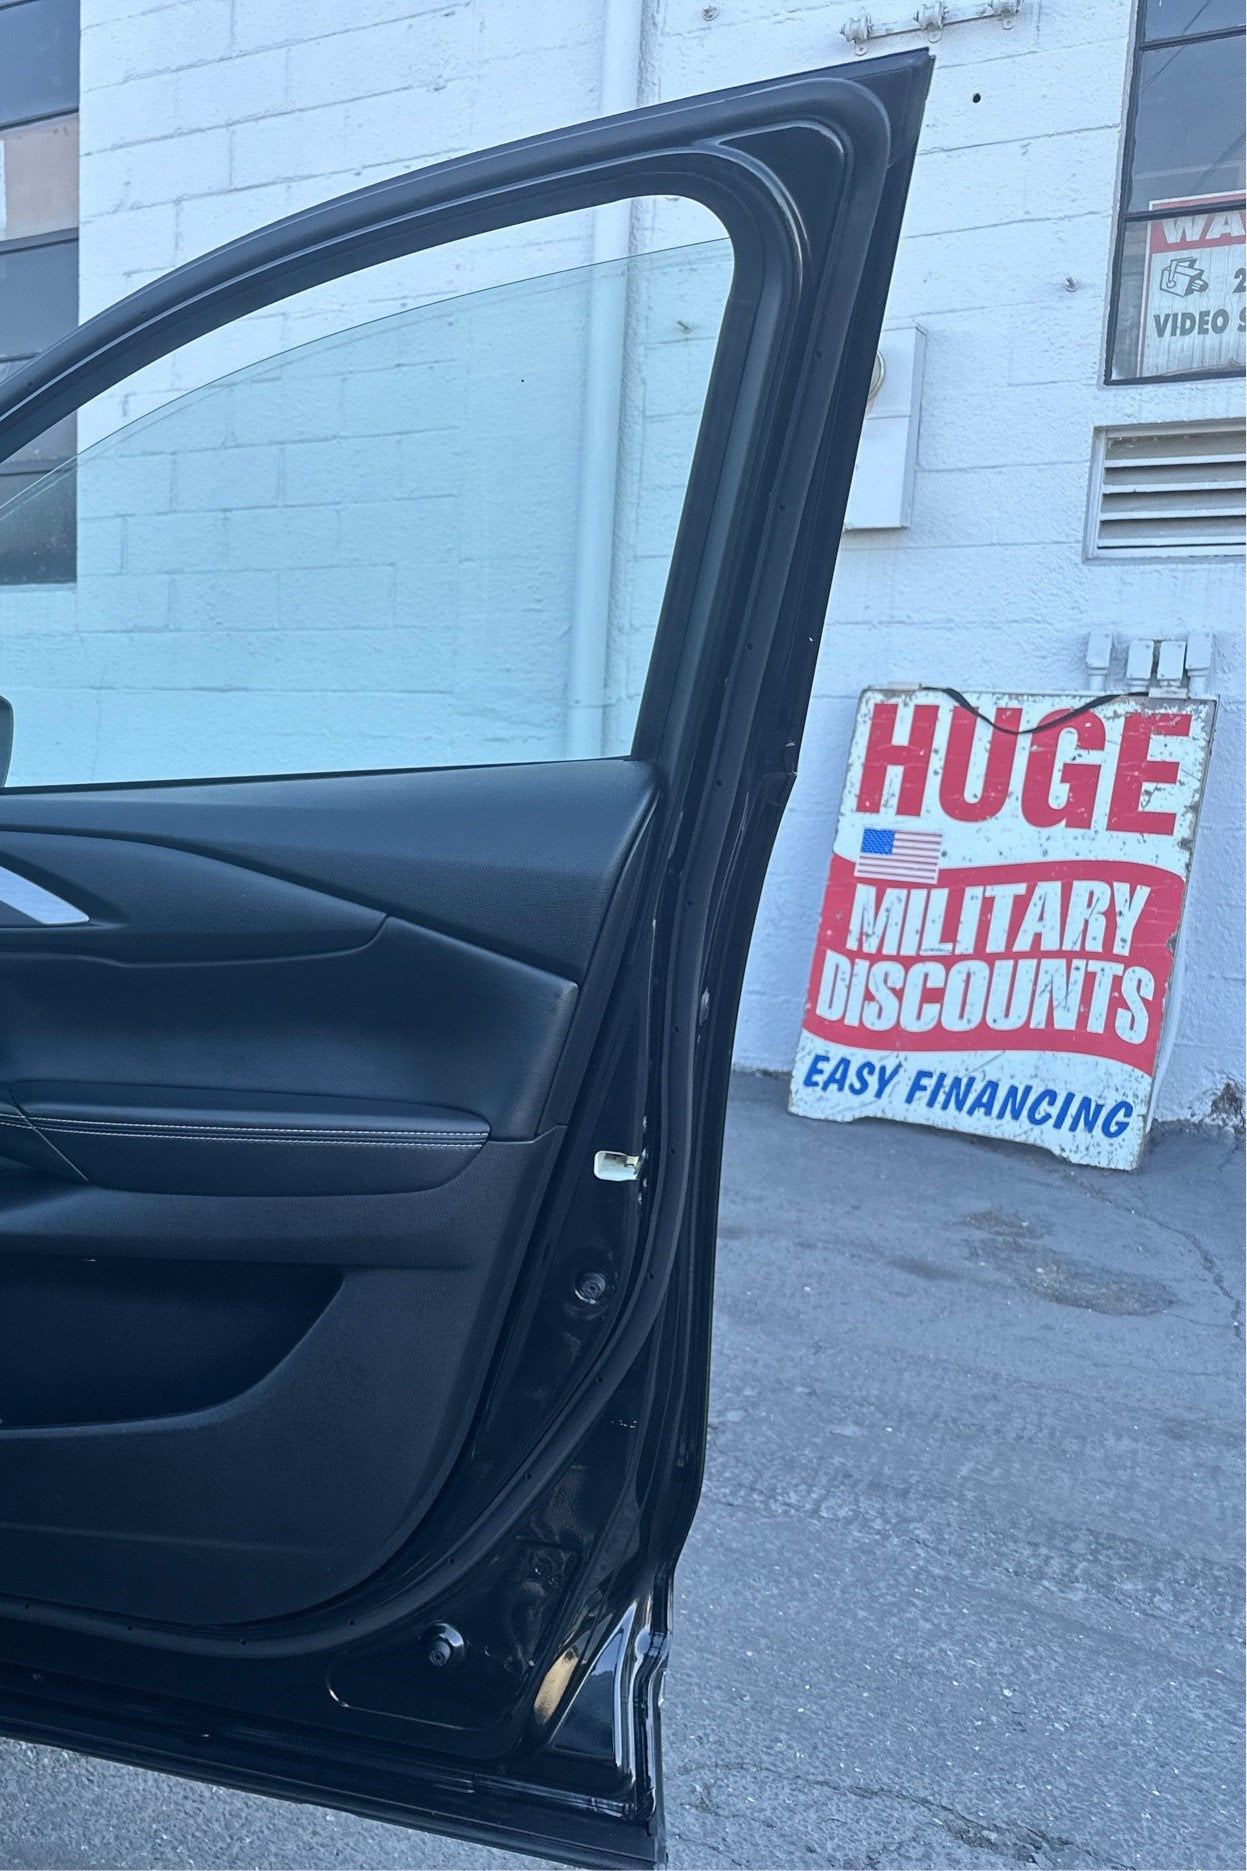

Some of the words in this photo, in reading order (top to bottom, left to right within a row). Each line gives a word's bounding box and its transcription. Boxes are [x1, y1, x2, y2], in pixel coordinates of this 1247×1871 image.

[1153, 308, 1230, 338] VIDEO
[855, 702, 1193, 836] HUGE
[845, 880, 1151, 957] MILITARY
[815, 949, 1156, 1045] DISCOUNTS
[802, 1053, 902, 1100] EASY
[905, 1070, 1134, 1139] FINANCING
